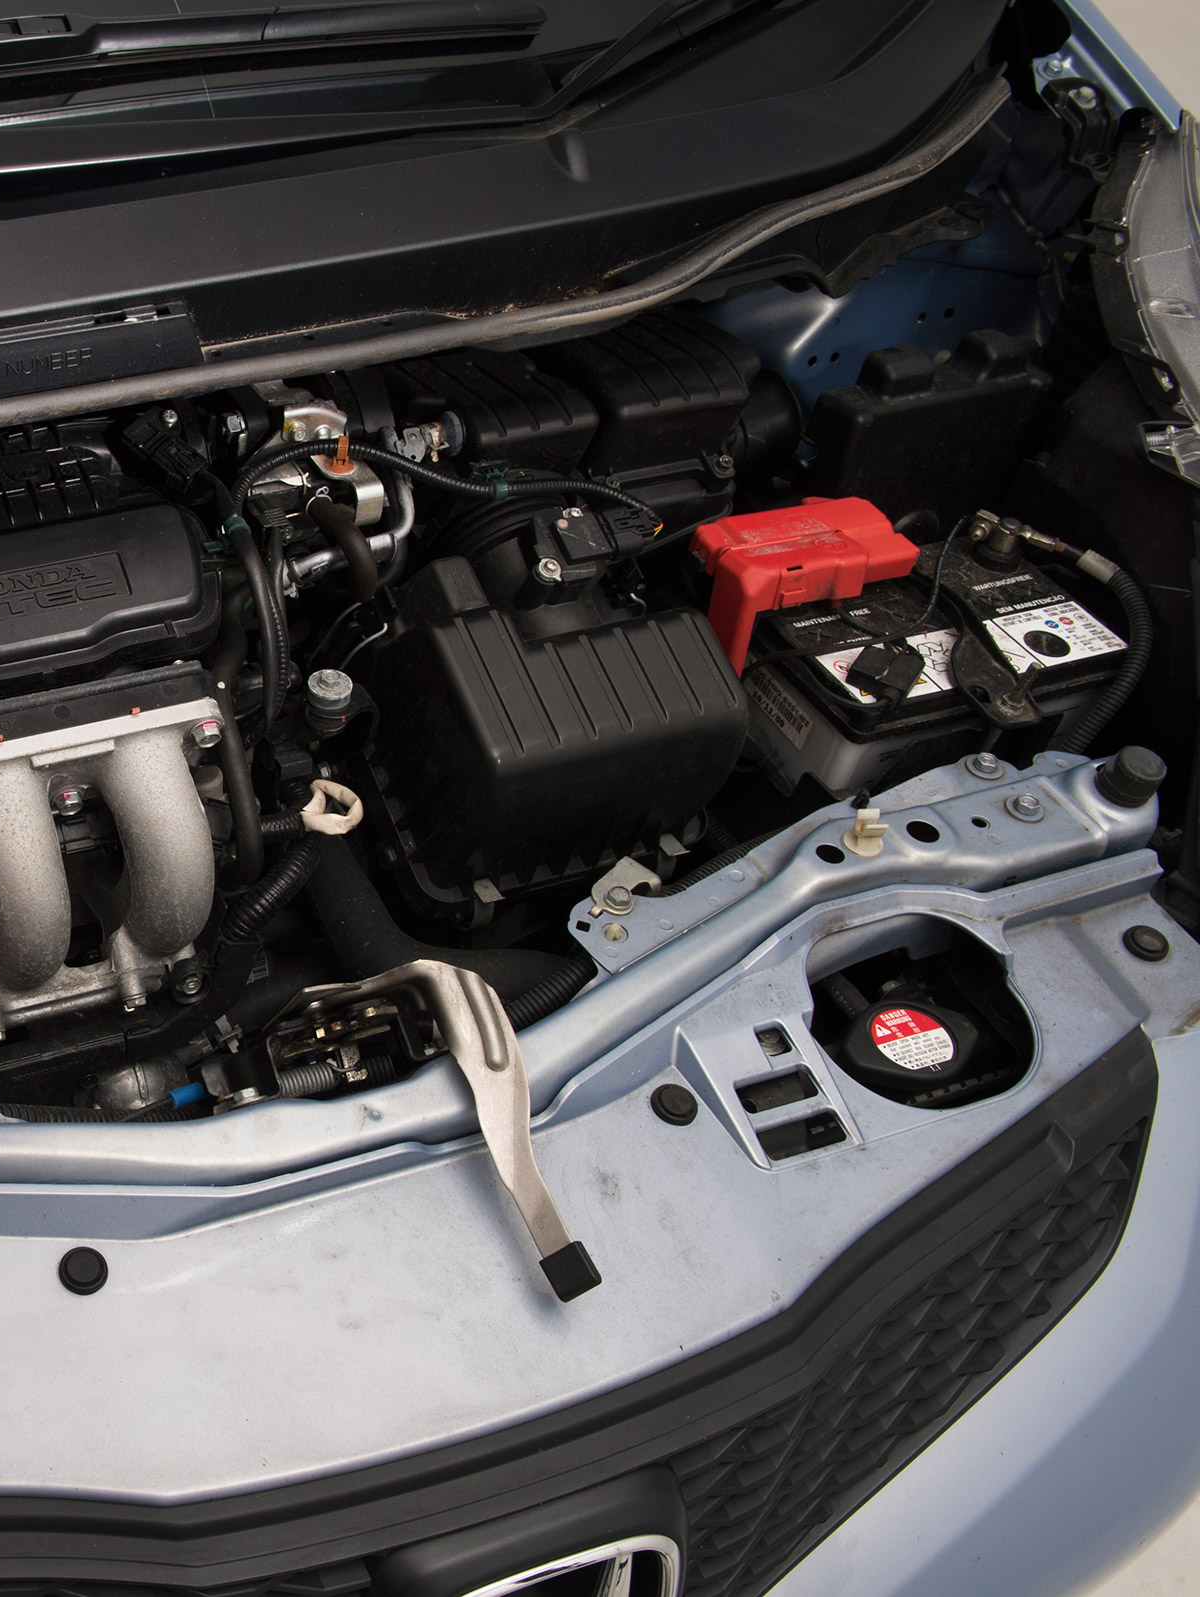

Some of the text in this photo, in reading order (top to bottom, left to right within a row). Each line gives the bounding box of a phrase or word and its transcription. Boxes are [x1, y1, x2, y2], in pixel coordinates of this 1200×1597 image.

[6, 347, 93, 377] NUMBER
[848, 607, 872, 617] FREE
[880, 1009, 908, 1021] DANGER
